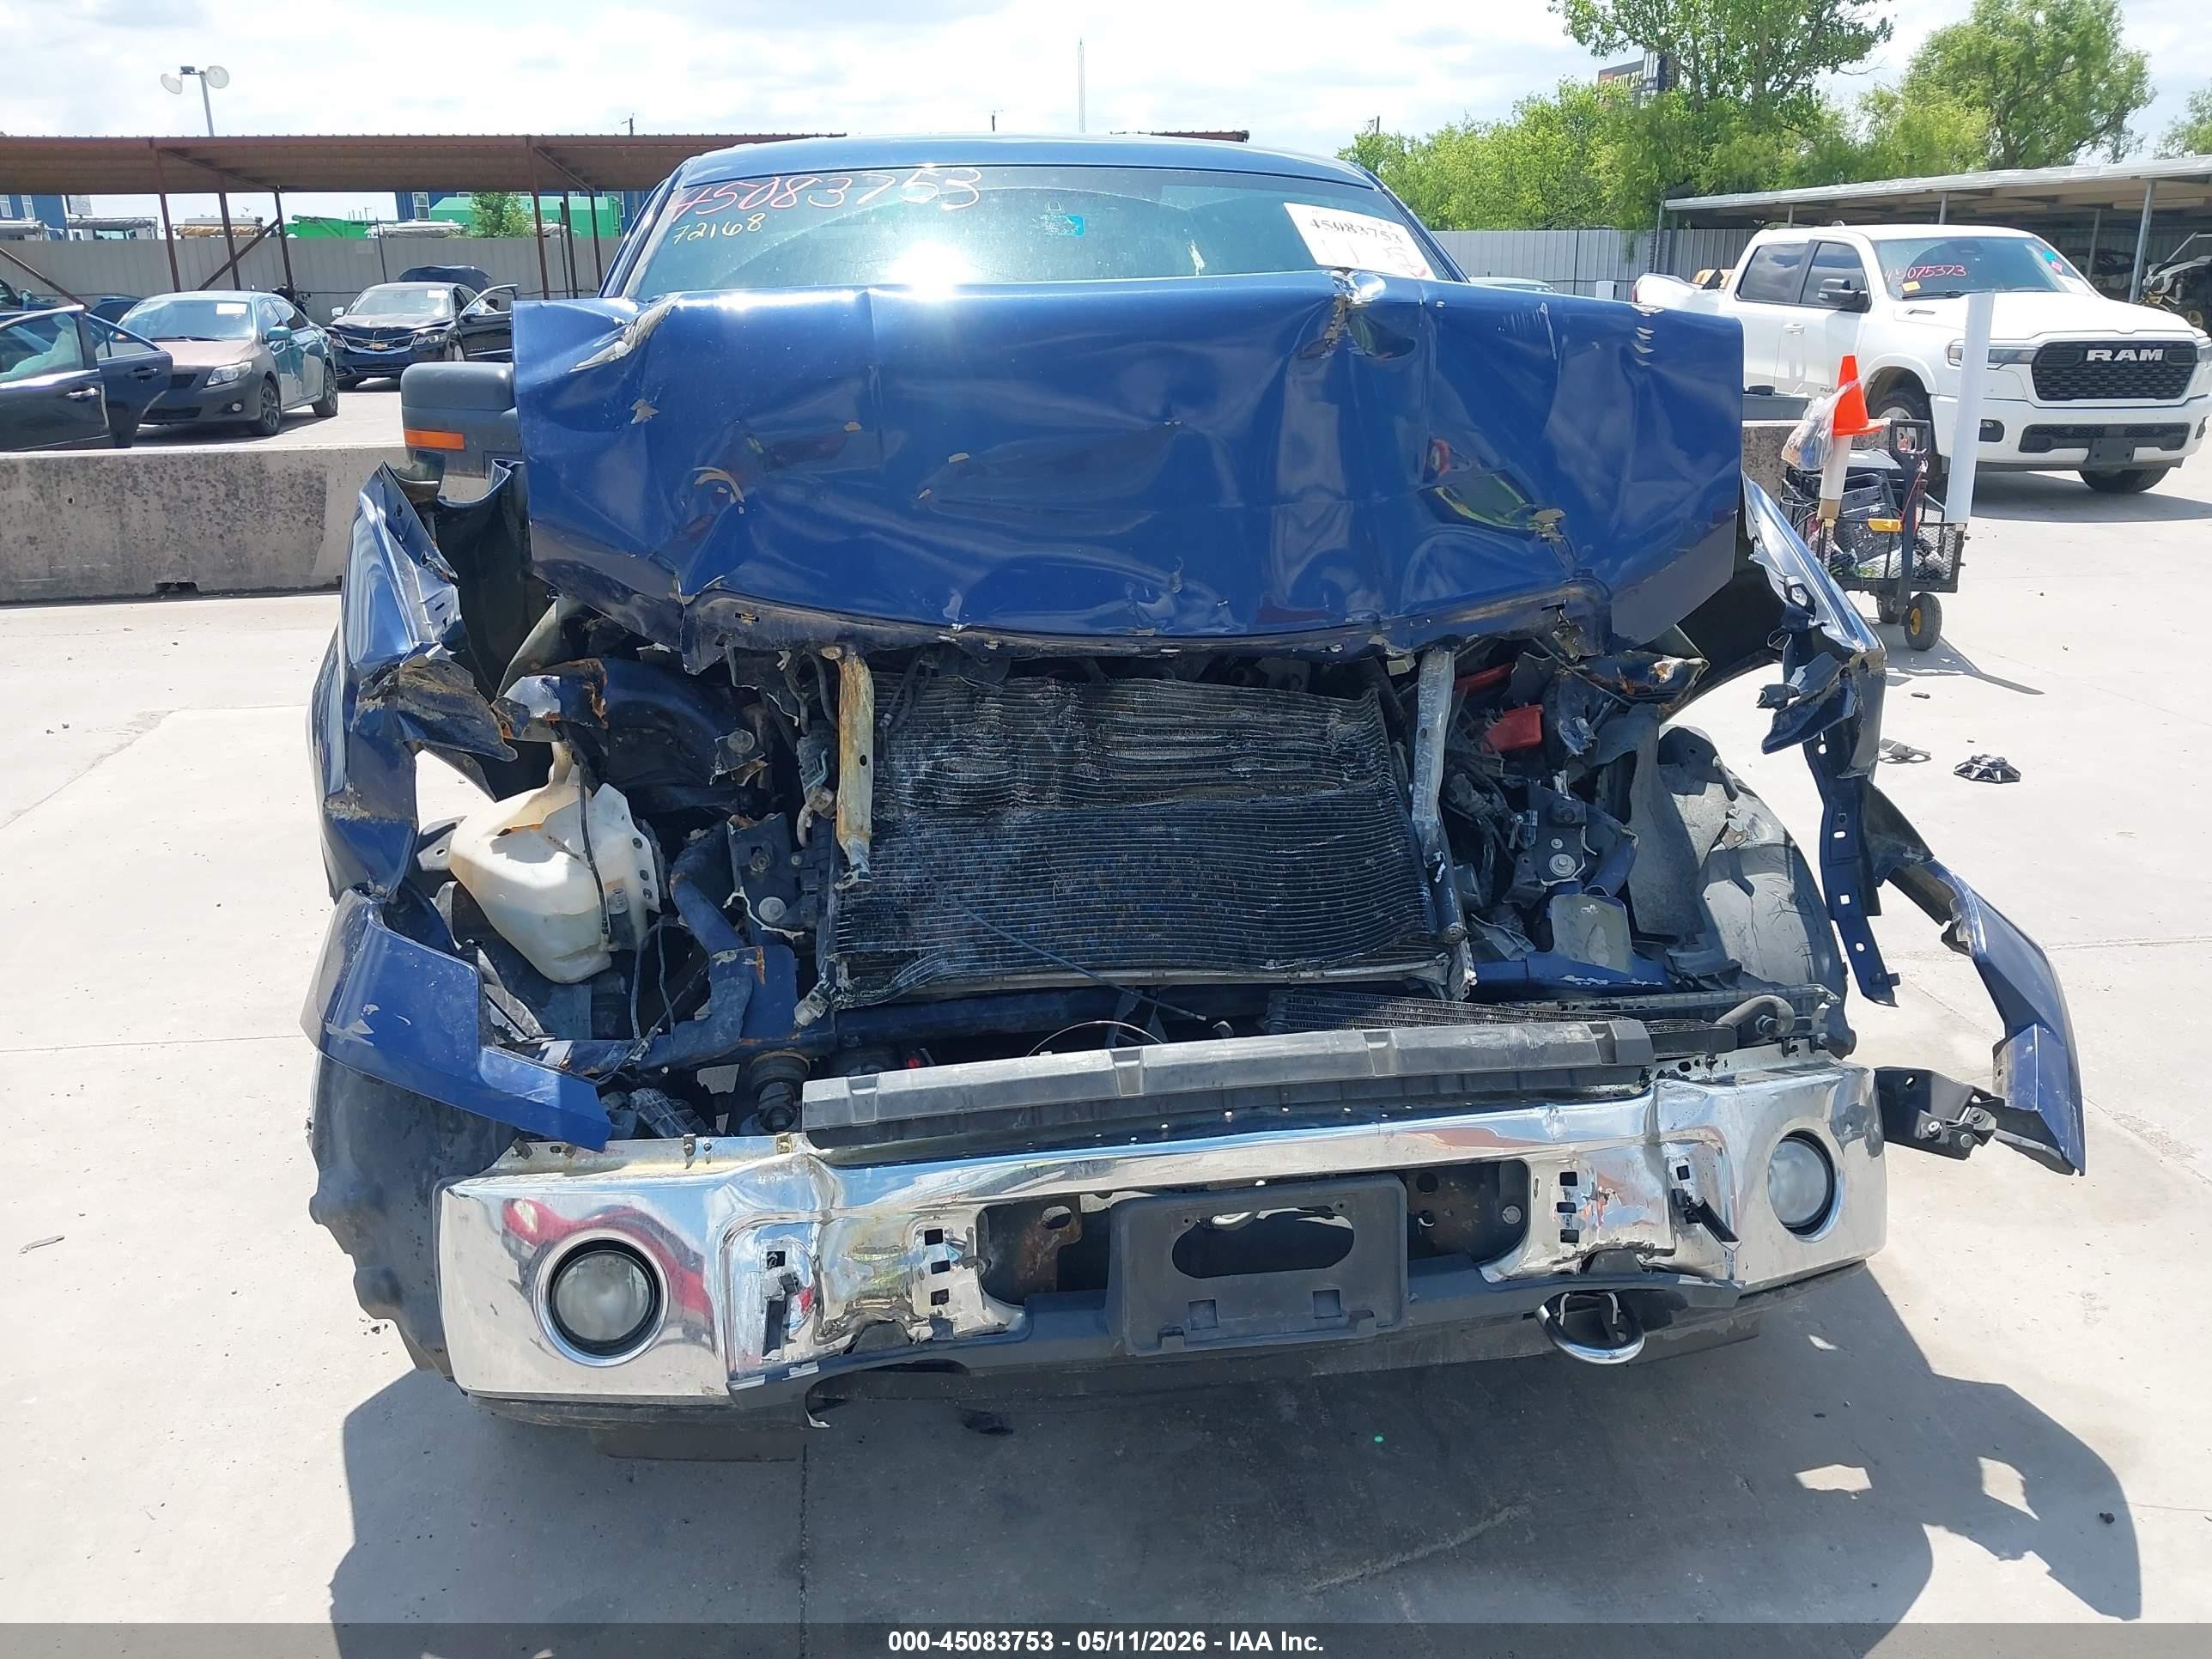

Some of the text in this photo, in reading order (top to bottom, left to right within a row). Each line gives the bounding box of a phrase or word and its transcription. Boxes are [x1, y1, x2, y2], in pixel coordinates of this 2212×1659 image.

[668, 167, 982, 222] 45083753
[673, 212, 766, 245] 72168
[2086, 349, 2164, 362] RAM
